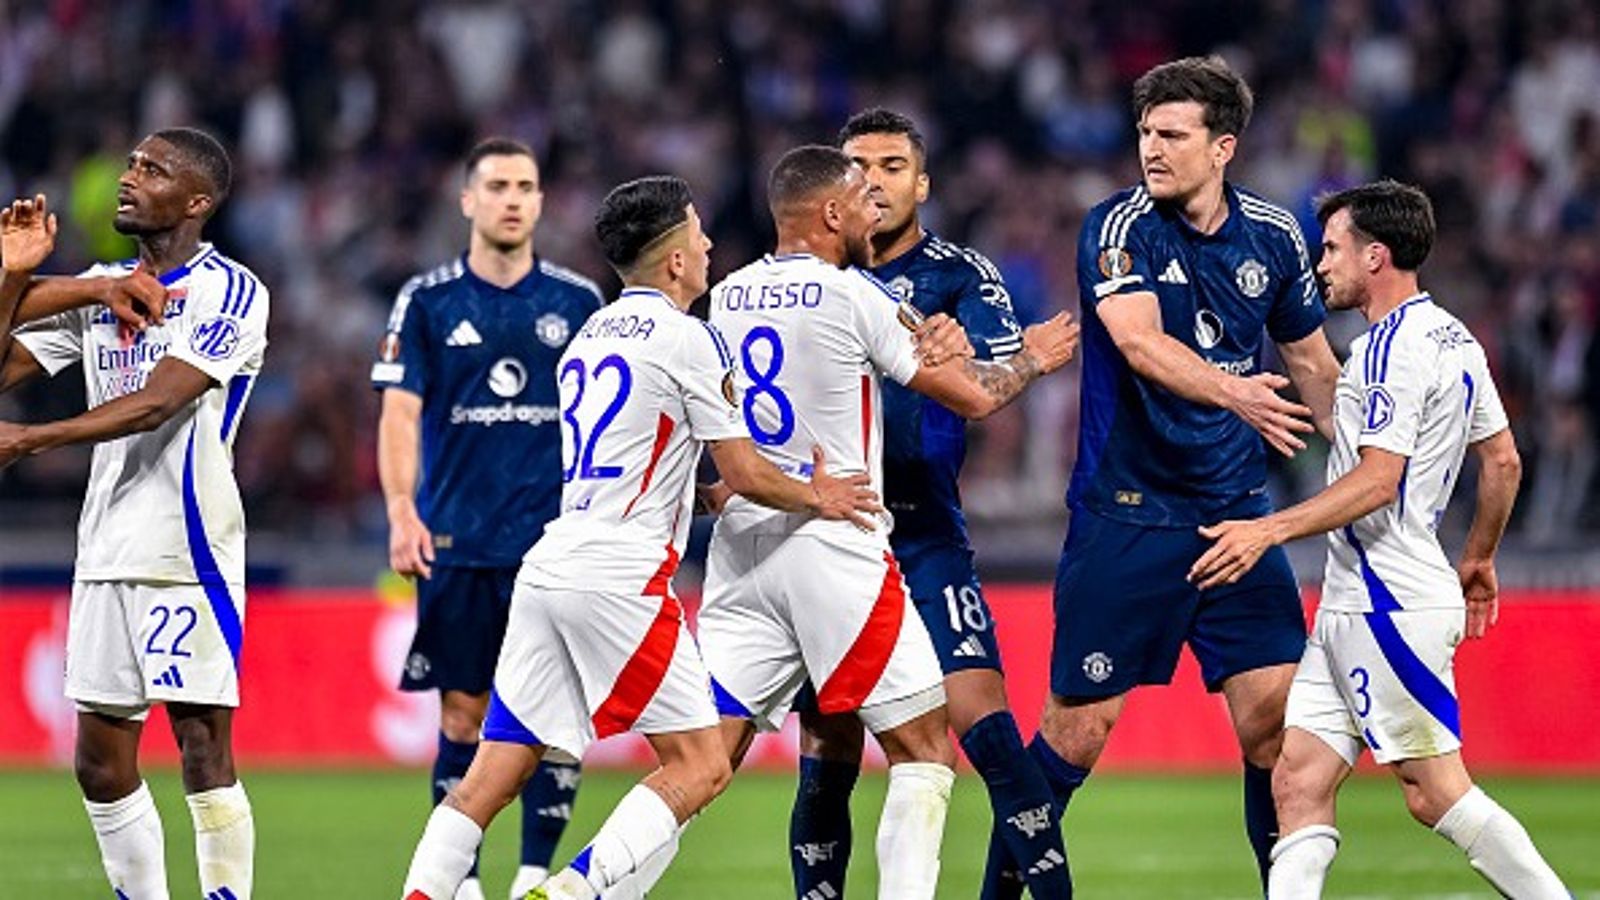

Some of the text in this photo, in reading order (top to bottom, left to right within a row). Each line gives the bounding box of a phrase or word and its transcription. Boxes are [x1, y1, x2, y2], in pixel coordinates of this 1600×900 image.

[195, 320, 236, 357] MG
[740, 325, 796, 447] 8
[559, 353, 633, 484] 32
[145, 605, 198, 658] 22
[943, 584, 988, 633] 18
[1349, 667, 1372, 718] 3
